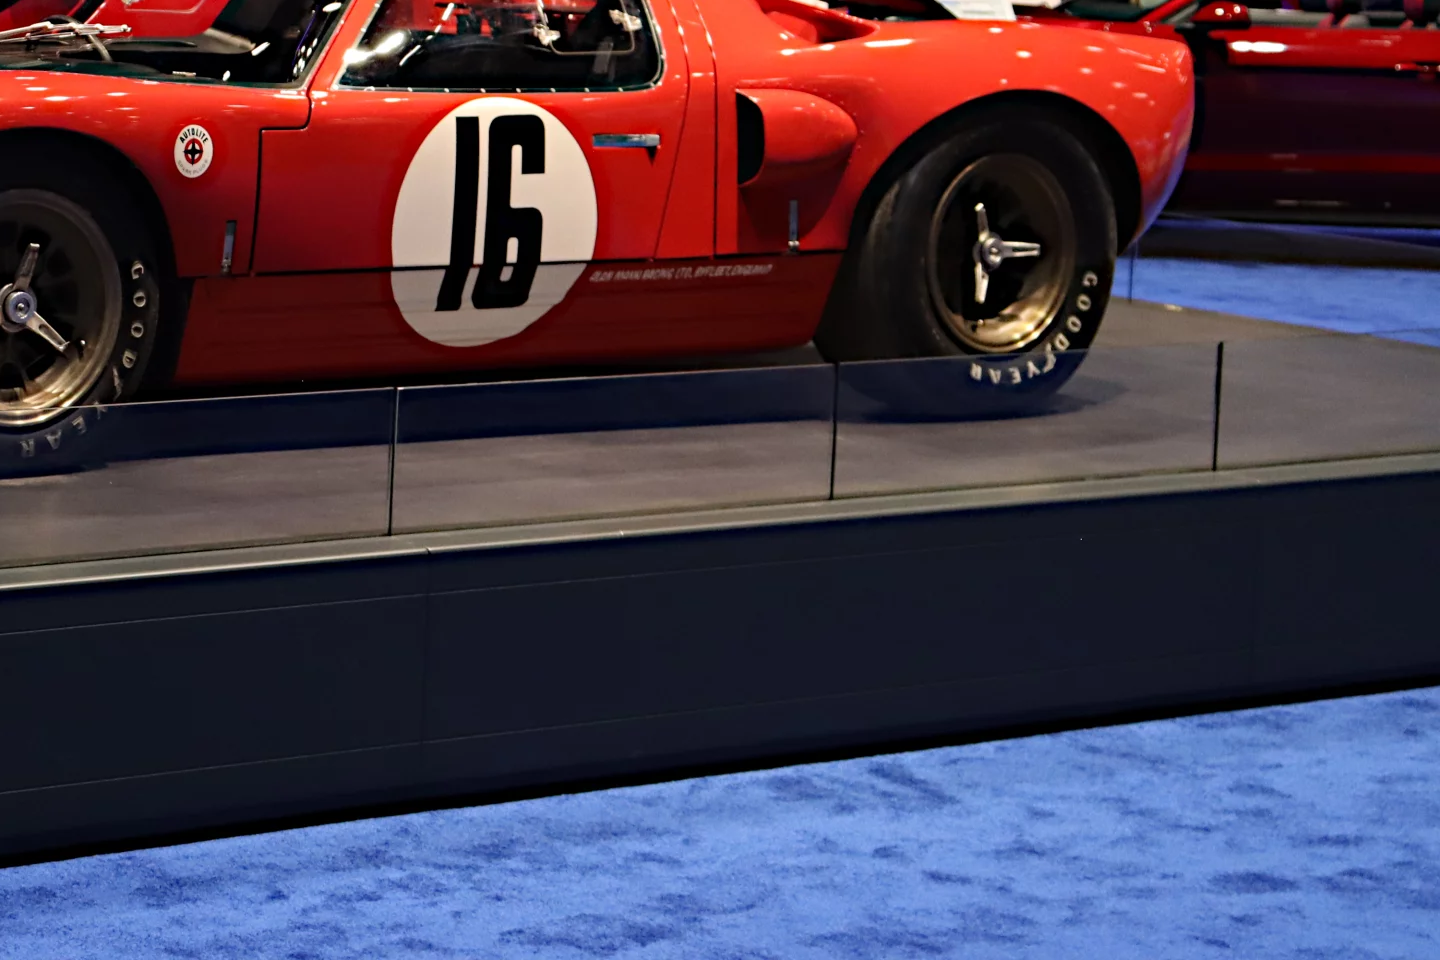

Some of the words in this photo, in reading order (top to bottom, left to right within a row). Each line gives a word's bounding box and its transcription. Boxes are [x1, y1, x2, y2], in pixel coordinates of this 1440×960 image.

[179, 127, 209, 144] AUTOLITE
[435, 113, 545, 312] 16
[969, 270, 1099, 385] GOODYEAR
